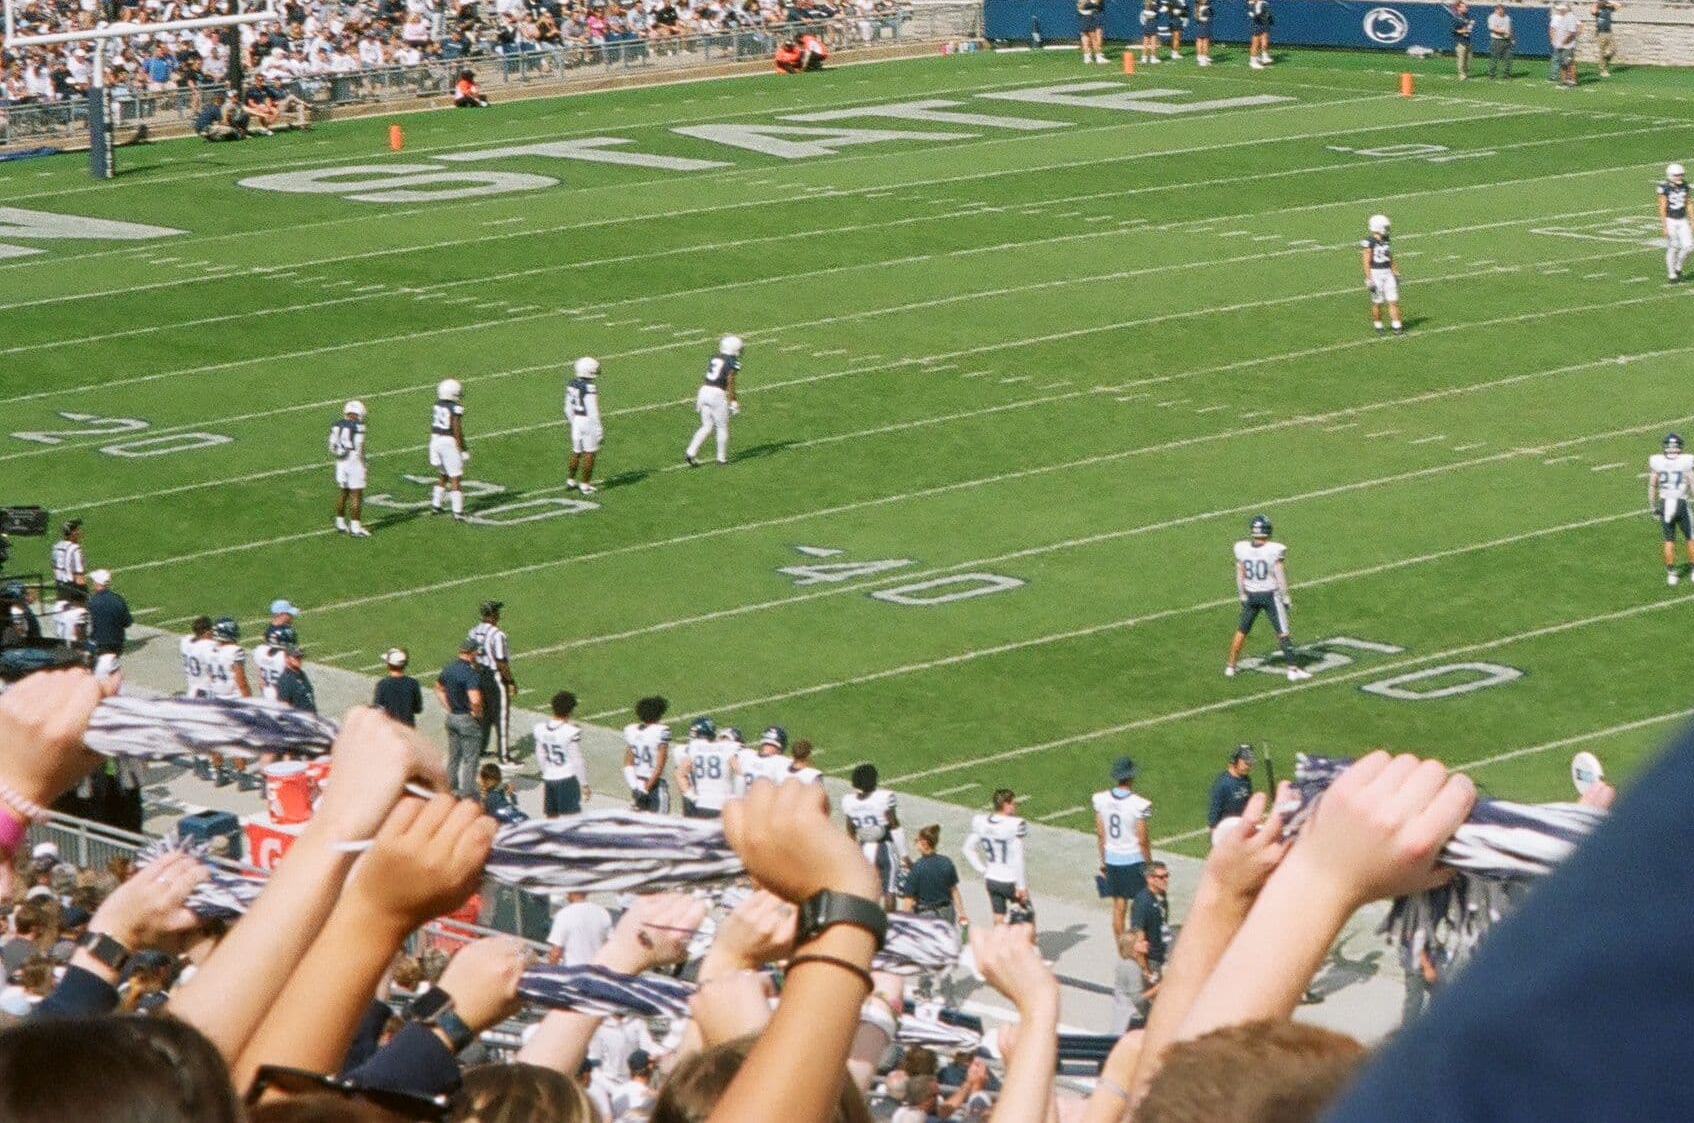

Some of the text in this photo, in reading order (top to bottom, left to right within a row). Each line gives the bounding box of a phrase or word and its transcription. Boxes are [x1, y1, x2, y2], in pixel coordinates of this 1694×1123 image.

[236, 81, 1298, 203] STATE
[706, 357, 725, 381] 3
[1109, 812, 1121, 839] 8
